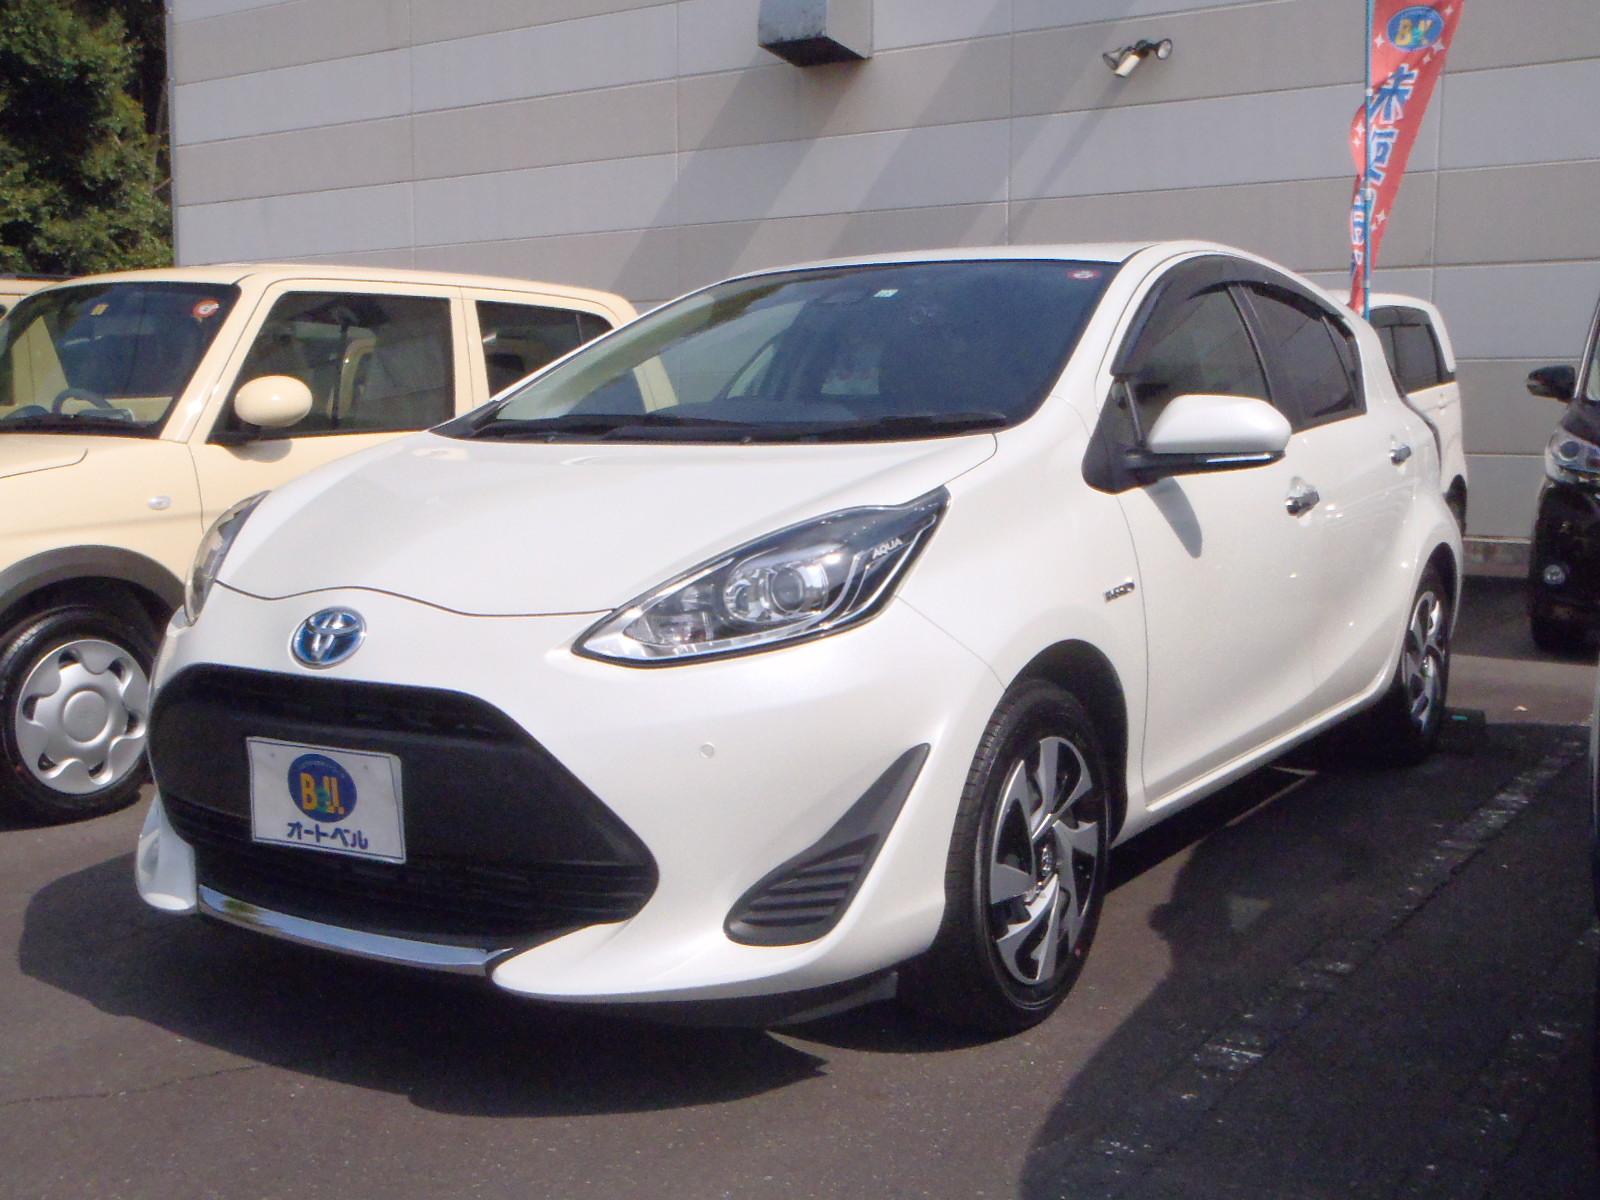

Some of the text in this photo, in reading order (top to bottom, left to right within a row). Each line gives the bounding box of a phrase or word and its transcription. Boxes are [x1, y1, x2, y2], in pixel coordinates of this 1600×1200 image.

[872, 537, 903, 560] AQUA
[287, 821, 369, 850] オートベル
